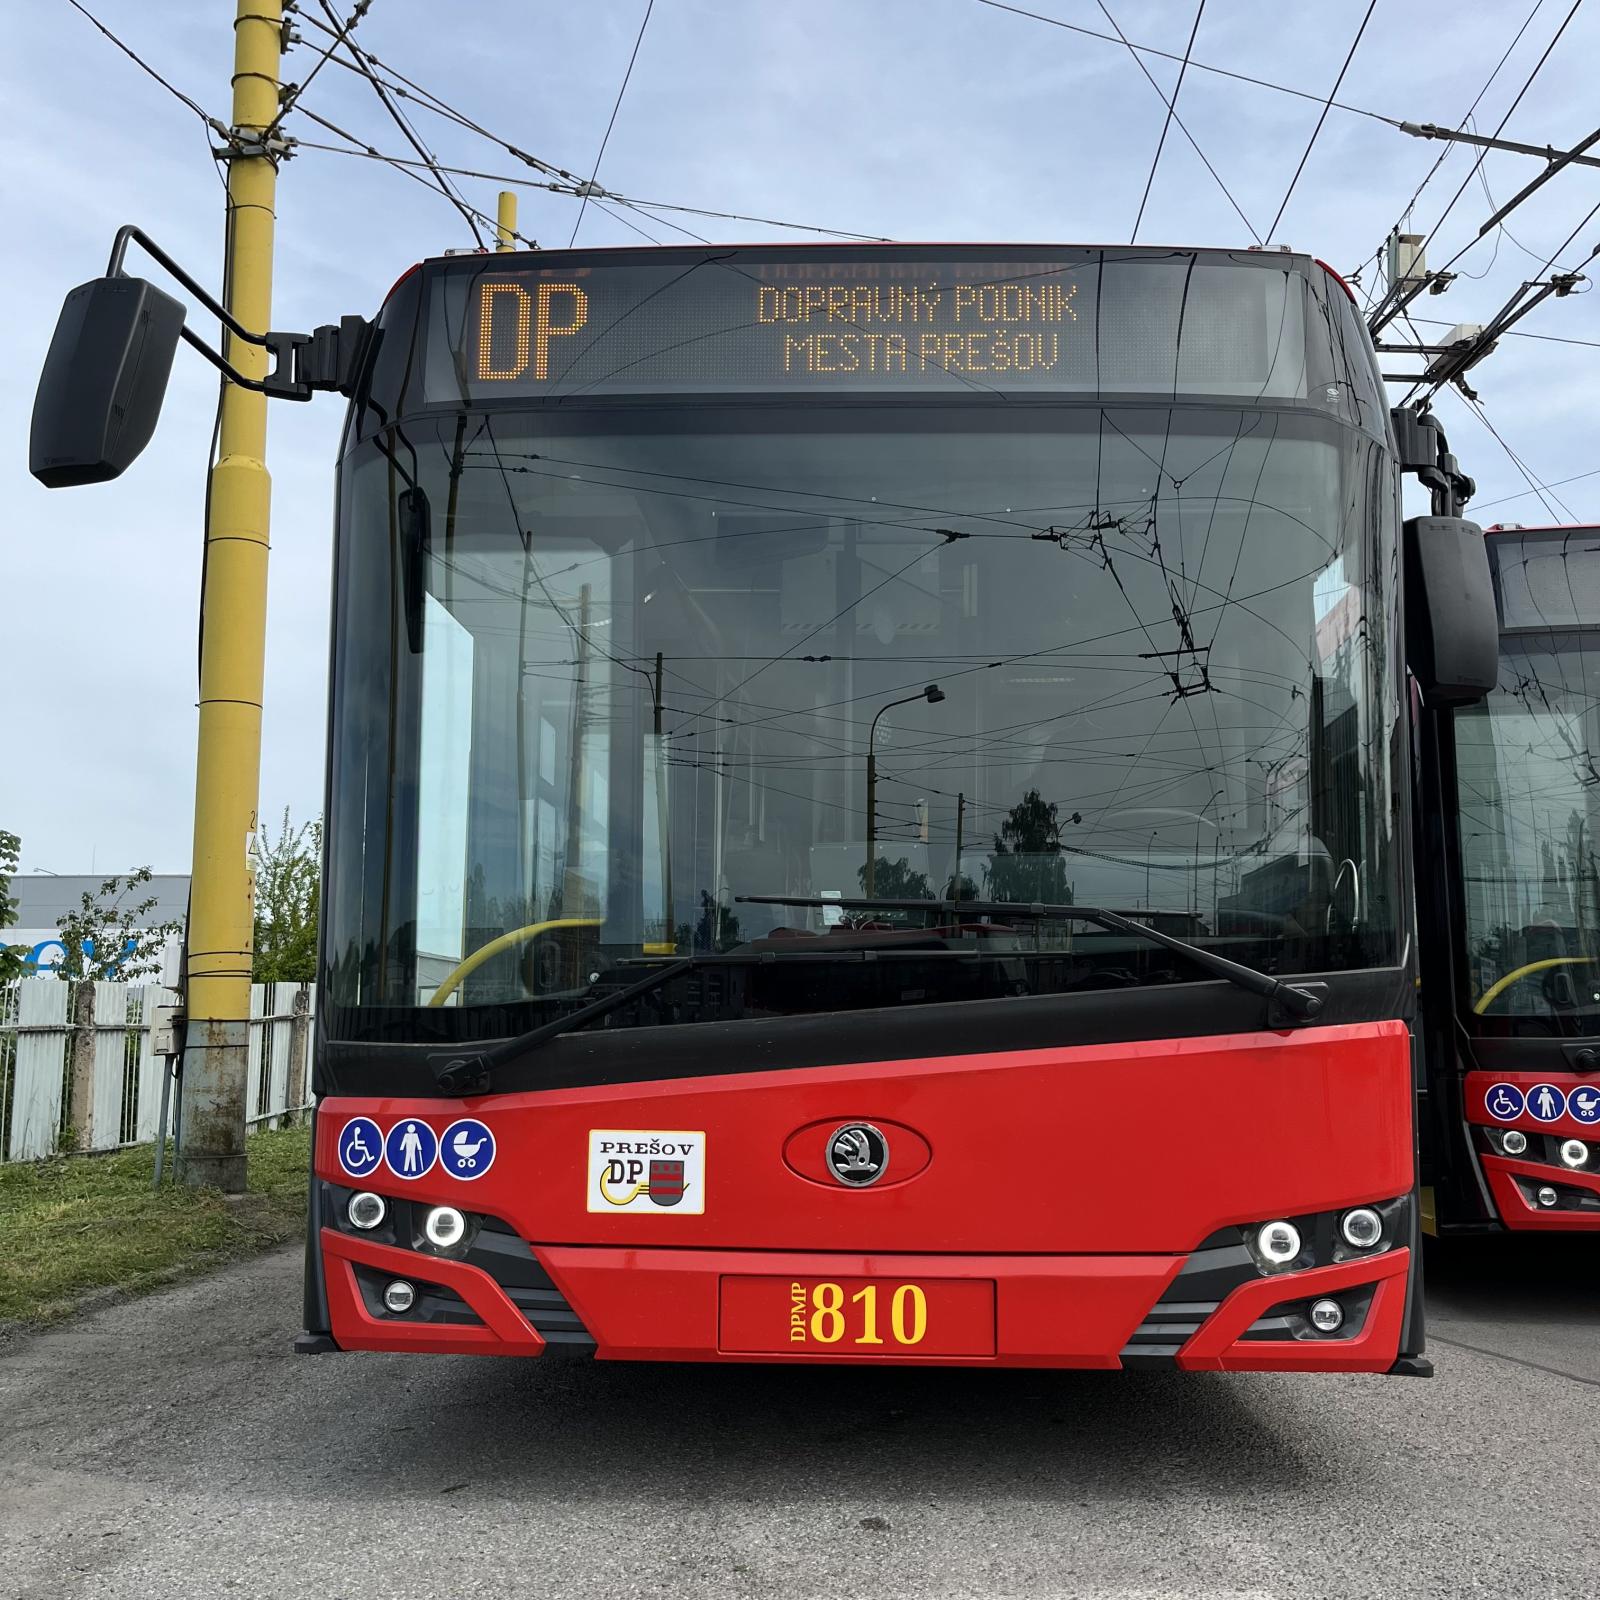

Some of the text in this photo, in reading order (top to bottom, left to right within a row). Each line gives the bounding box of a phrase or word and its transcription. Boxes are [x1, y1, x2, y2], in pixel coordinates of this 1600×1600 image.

[760, 281, 1077, 322] DOPRAVNÝ PODNIK
[479, 284, 588, 380] DP
[785, 329, 1058, 371] MESTA PREŠOV
[600, 1138, 694, 1155] PREŠOV
[607, 1159, 644, 1184] DP
[791, 1282, 807, 1342] DPMP
[810, 1283, 927, 1344] 810
